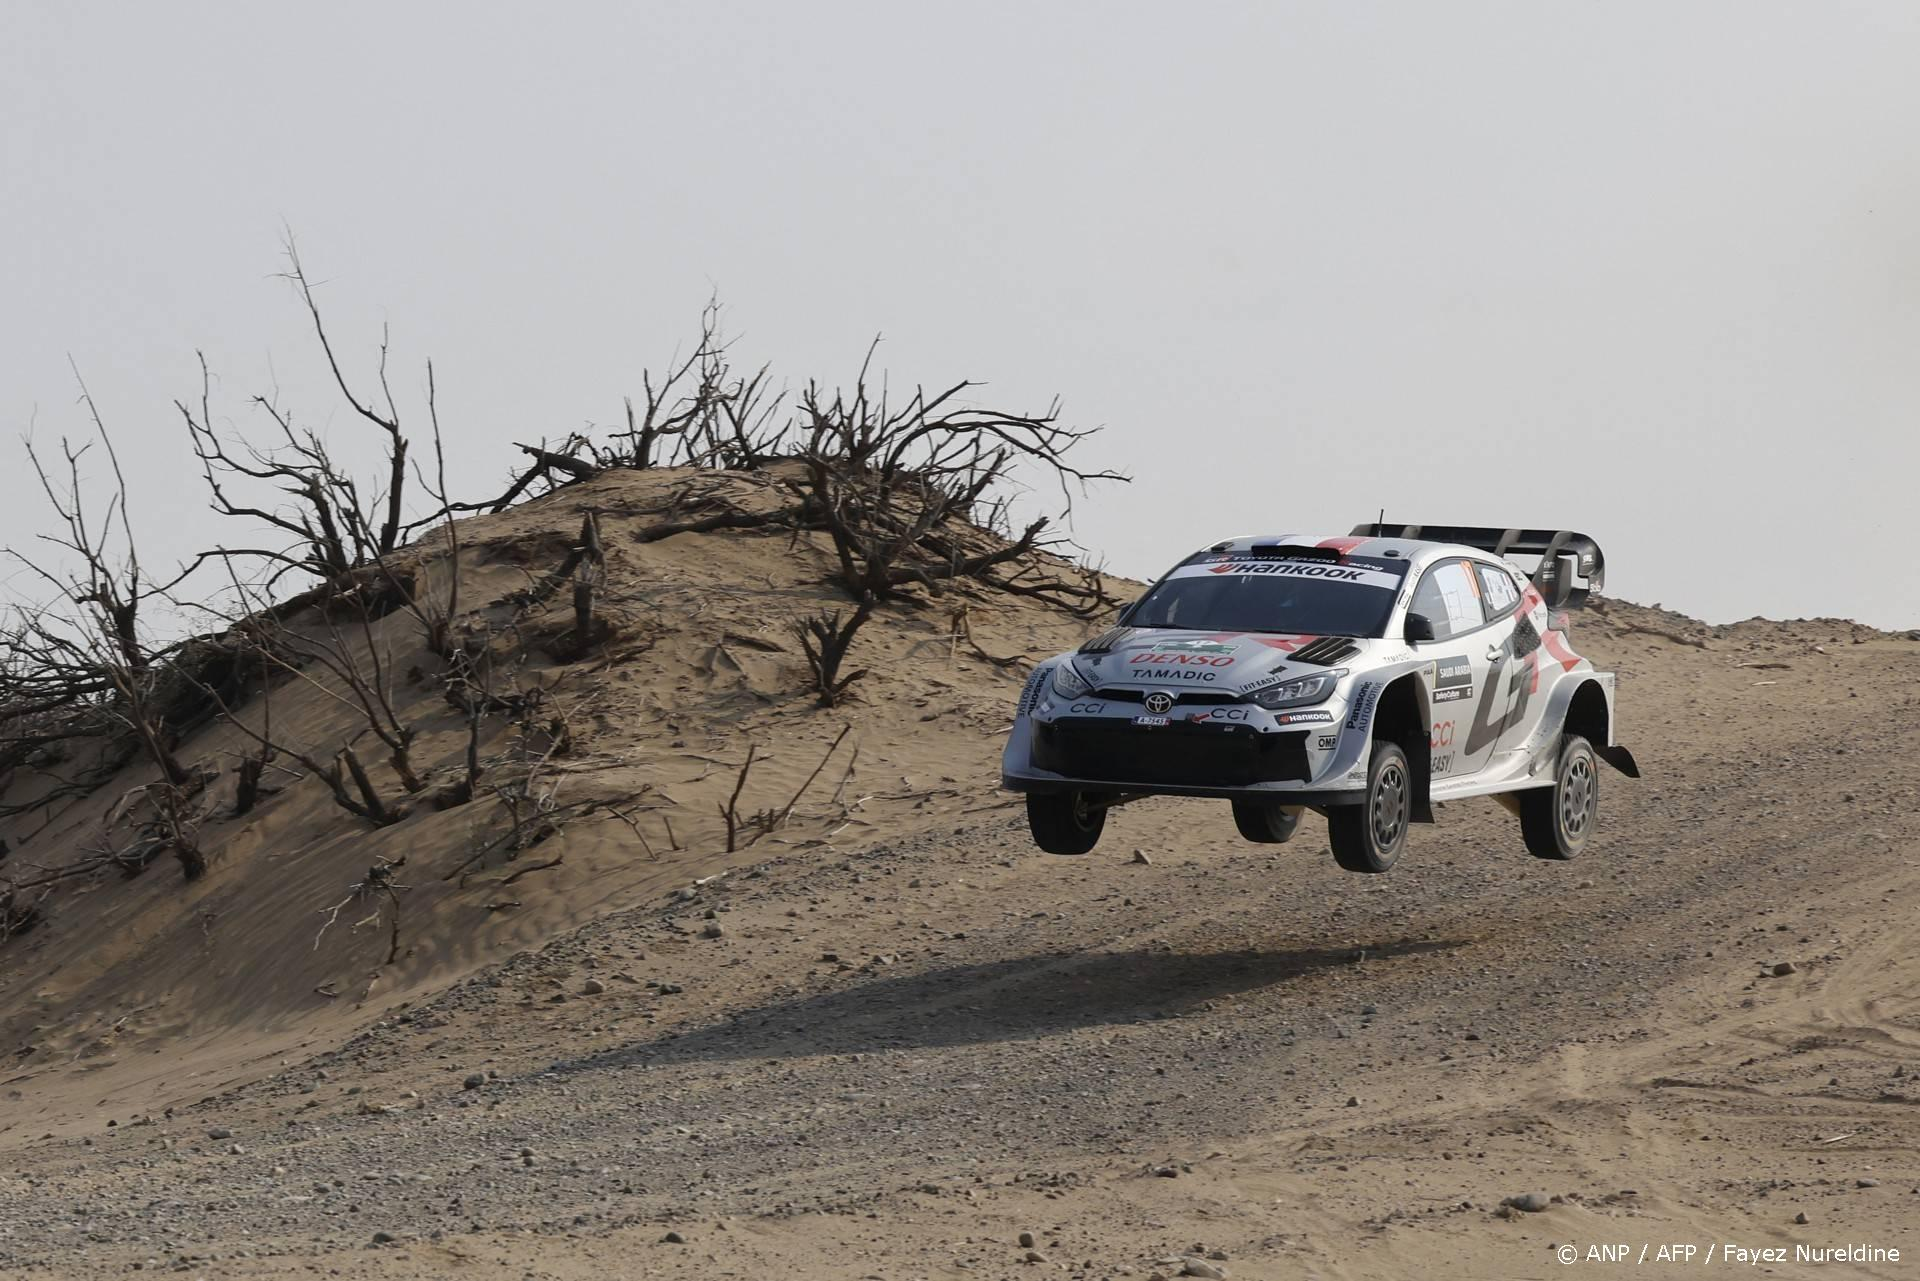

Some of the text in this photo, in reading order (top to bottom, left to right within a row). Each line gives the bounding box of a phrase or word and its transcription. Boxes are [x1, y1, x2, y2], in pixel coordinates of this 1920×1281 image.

[1129, 653, 1234, 667] DENSO
[1132, 669, 1216, 682] TAMADIC
[1439, 666, 1455, 679] SAUDI
[1345, 681, 1373, 730] Panasonic
[1358, 681, 1385, 733] AUTOMOTIVE
[1318, 738, 1337, 748] OMP
[1430, 751, 1456, 774] EASY]
